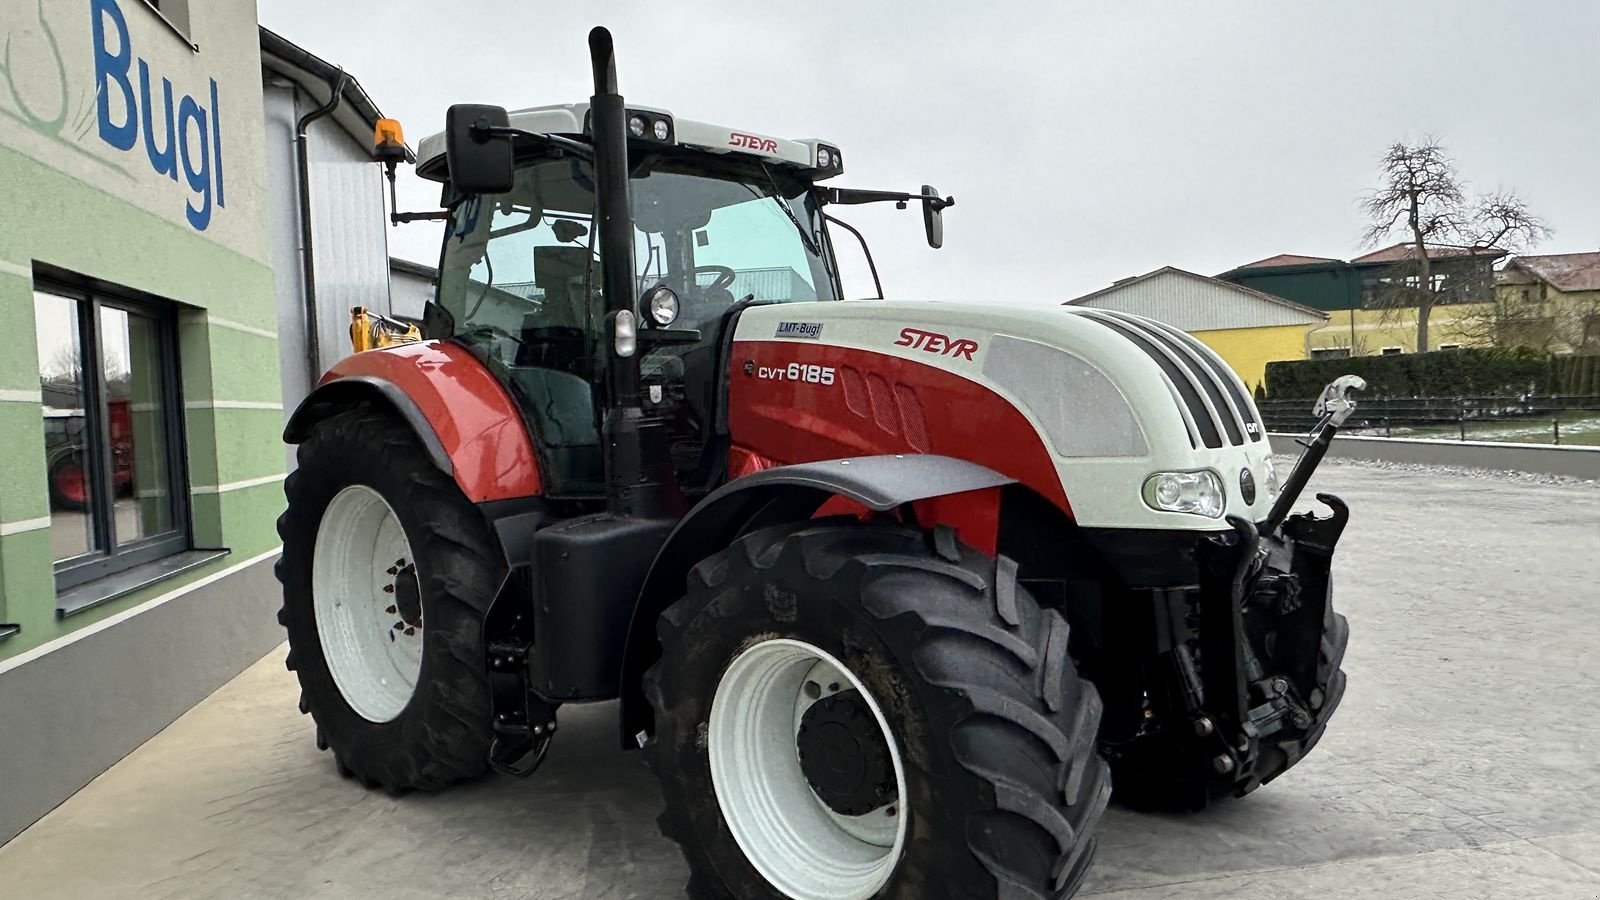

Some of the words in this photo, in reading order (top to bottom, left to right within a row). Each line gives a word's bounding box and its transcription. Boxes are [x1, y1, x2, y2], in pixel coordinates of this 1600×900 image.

[90, 0, 225, 231] Bugl
[728, 132, 777, 154] STEYR
[777, 322, 820, 336] LMT-Bugl
[893, 327, 979, 361] STEYR
[758, 366, 786, 380] CVT
[787, 362, 836, 385] 6185
